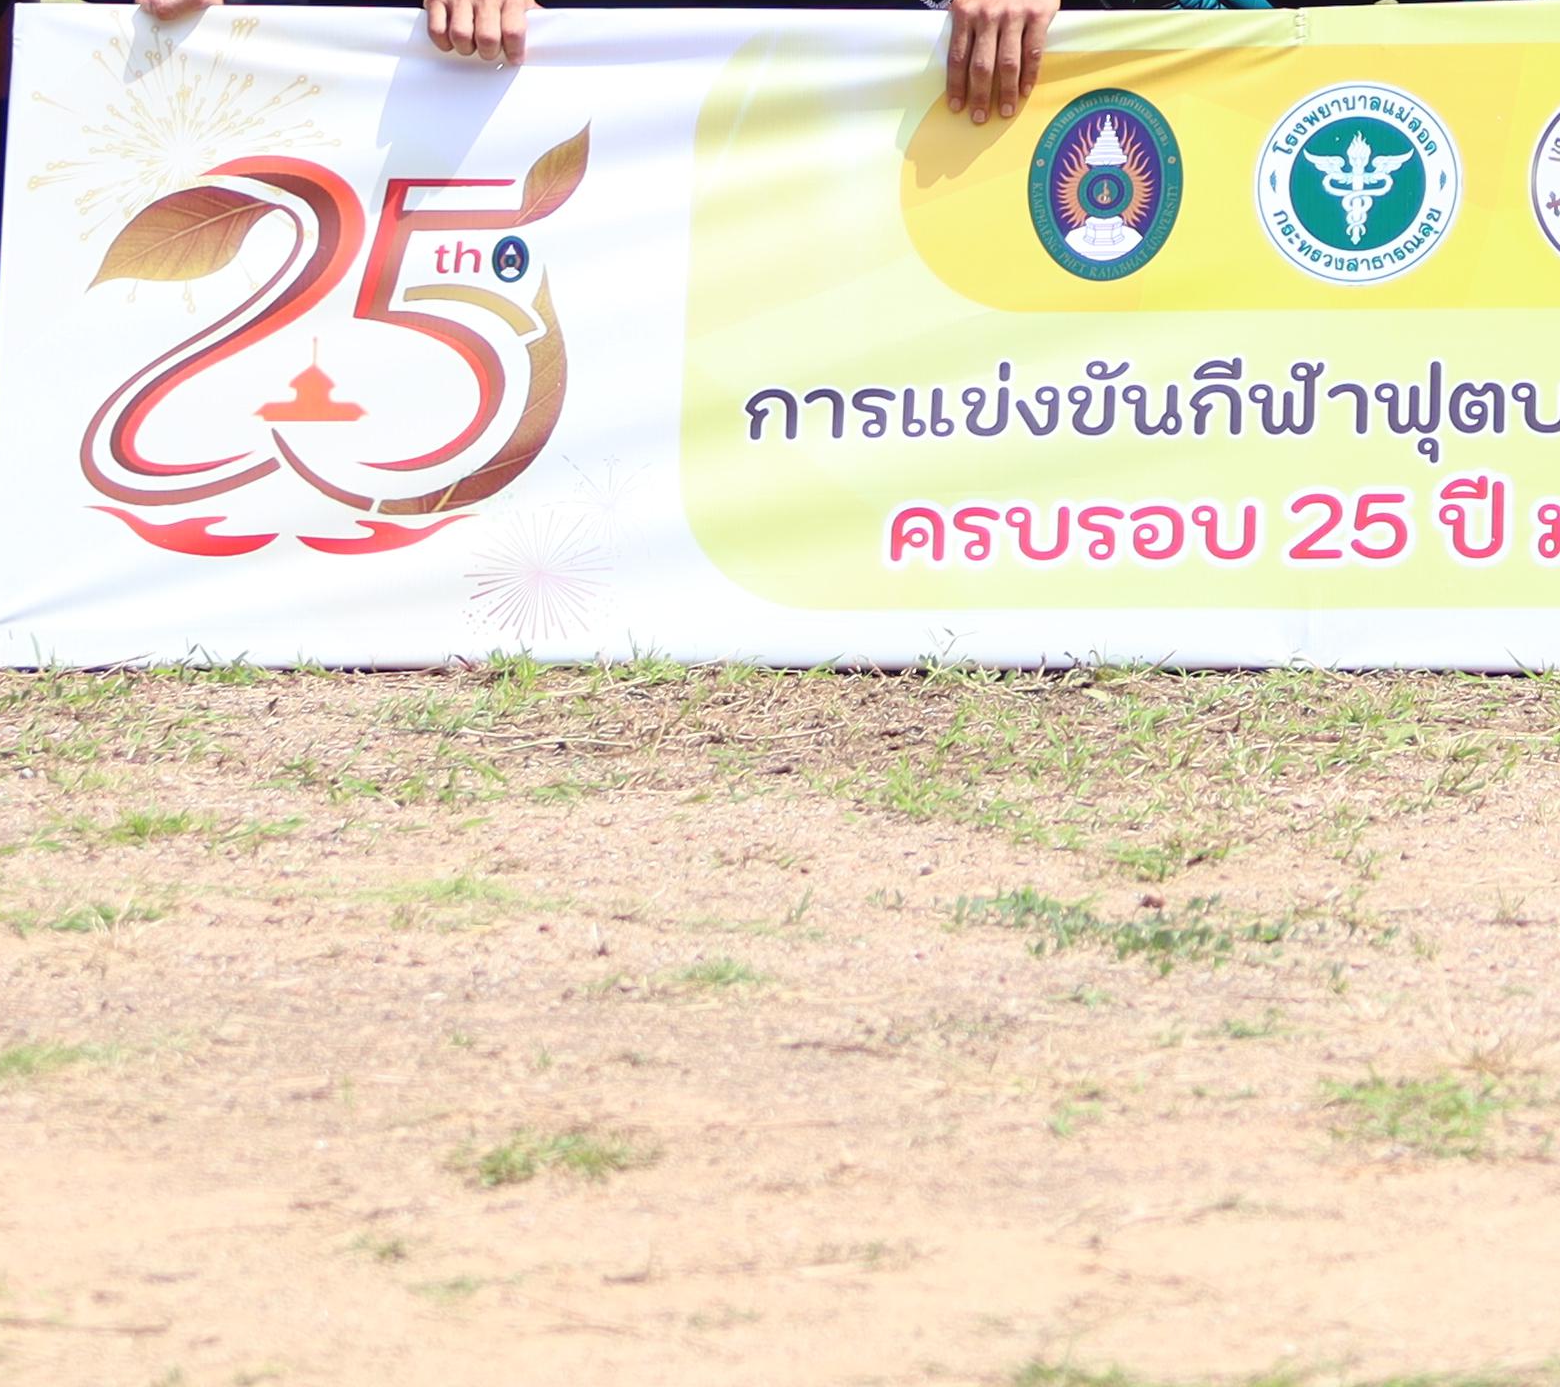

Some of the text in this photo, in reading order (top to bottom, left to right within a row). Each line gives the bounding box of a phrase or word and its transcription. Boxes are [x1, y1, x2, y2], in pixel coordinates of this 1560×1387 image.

[1272, 94, 1439, 157] โรงพยาบาลแม่สอด
[435, 241, 481, 274] th
[1059, 251, 1087, 273] PHET
[1146, 183, 1178, 251] UNIVERSITY
[1273, 207, 1443, 272] กระทรวงสาธารณสุข
[890, 501, 1258, 562] ครบรอบ
[1289, 493, 1408, 561] 25
[1438, 475, 1505, 560] ปี
